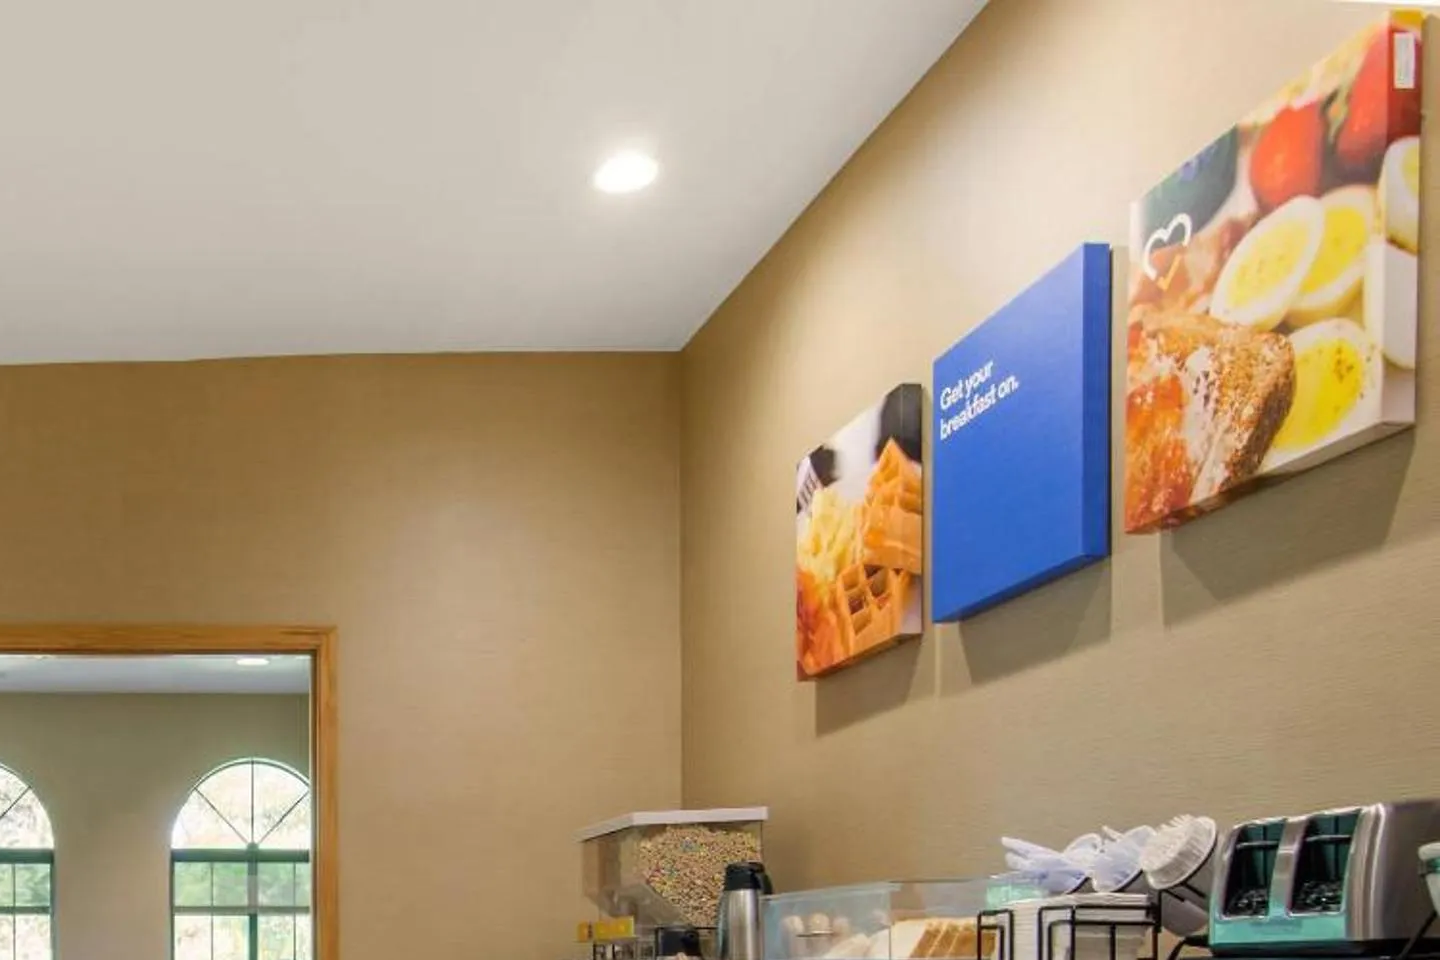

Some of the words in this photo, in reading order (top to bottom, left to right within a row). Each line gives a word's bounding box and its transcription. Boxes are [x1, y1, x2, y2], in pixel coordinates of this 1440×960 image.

[940, 379, 963, 410] Get
[964, 360, 993, 399] your
[940, 383, 996, 440] breakfast
[998, 375, 1019, 398] on.
